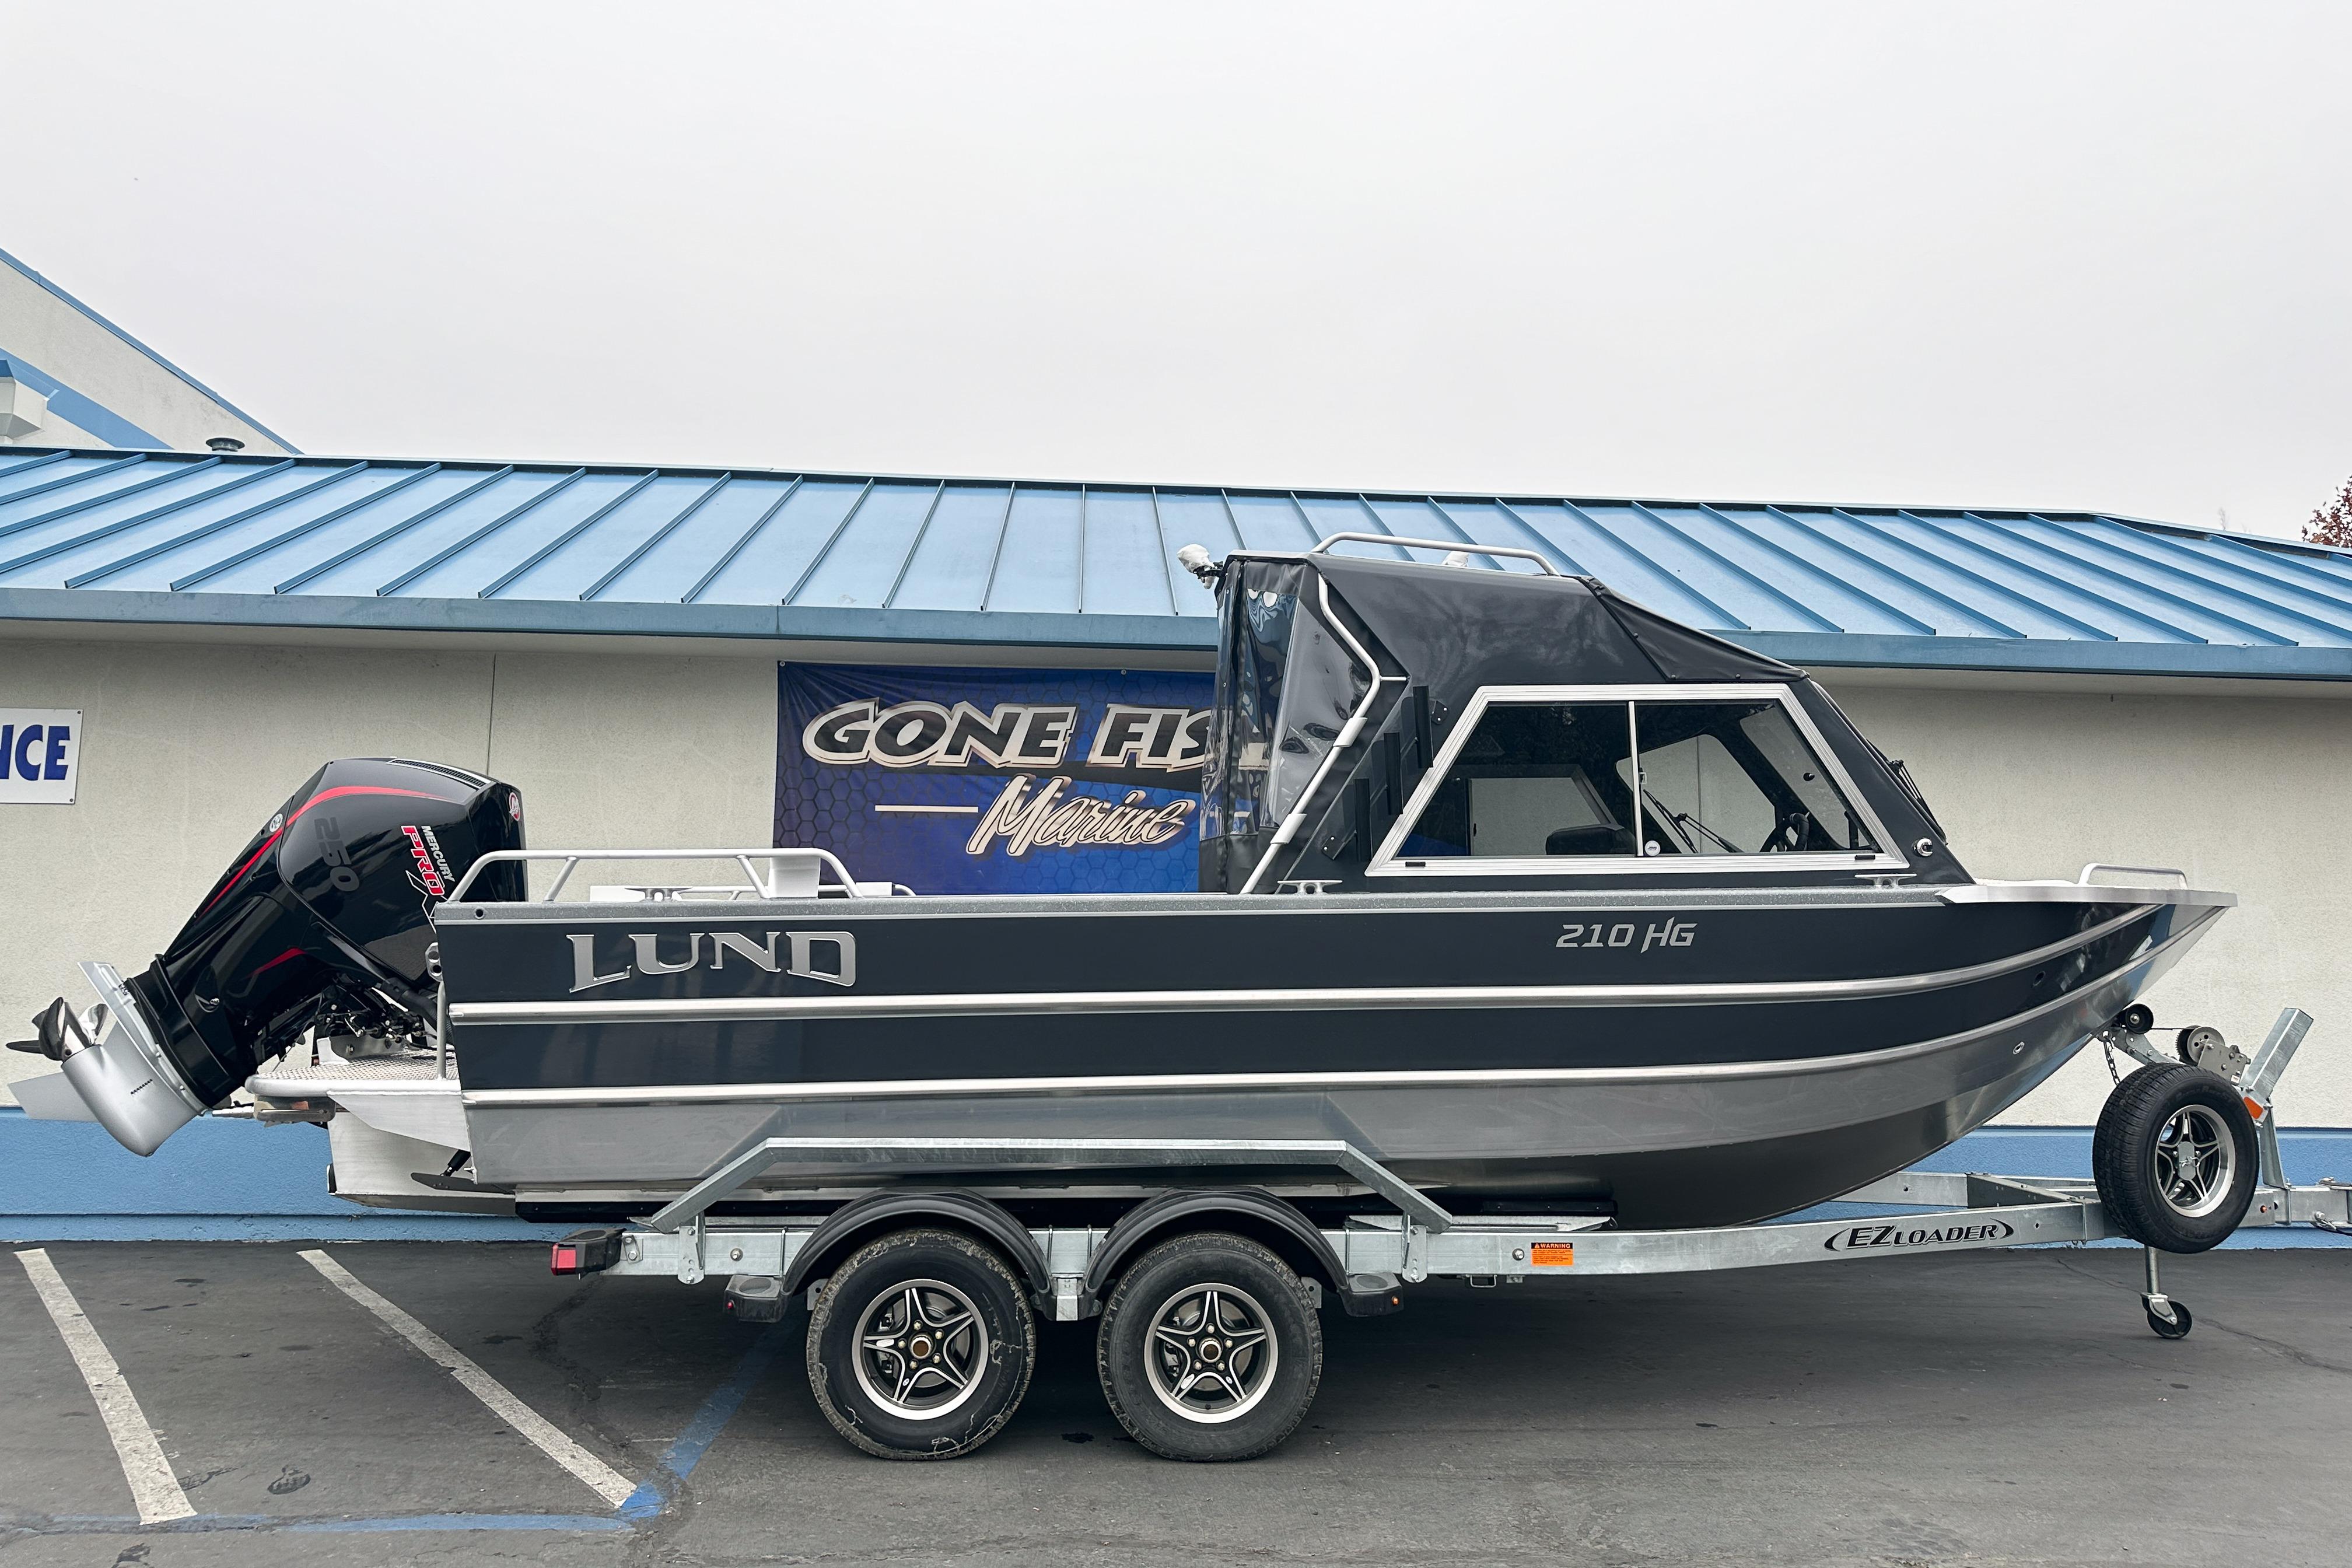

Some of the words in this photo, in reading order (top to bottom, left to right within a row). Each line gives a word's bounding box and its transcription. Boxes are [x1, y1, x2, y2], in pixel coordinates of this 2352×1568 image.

[803, 697, 1078, 768] GONE
[965, 774, 1196, 857] Marine
[314, 817, 360, 892] 250
[401, 825, 445, 896] PRO
[421, 825, 456, 883] MERCURY
[566, 930, 857, 993] LUND
[1555, 923, 1636, 948] 210
[1640, 916, 1698, 954] HG
